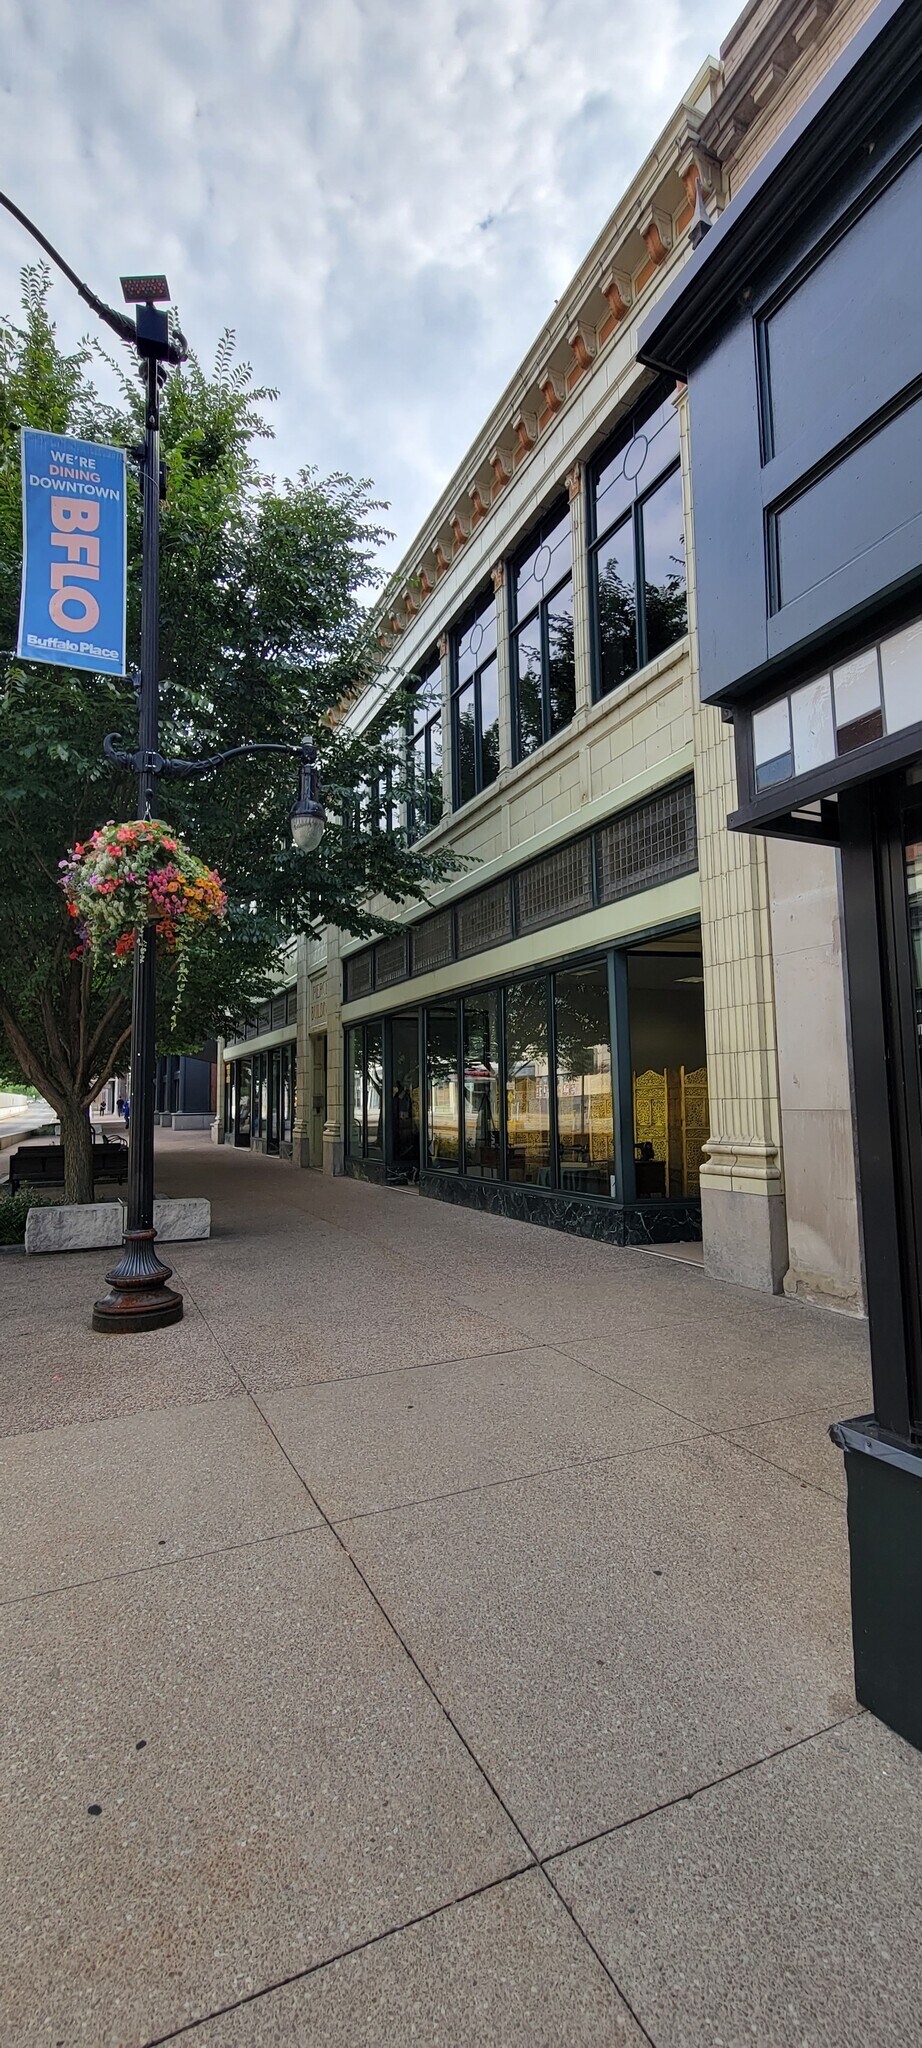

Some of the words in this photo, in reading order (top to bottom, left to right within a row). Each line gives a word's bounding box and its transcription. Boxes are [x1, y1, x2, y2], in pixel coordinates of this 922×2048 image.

[50, 450, 96, 470] WE'RE
[49, 464, 101, 483] DINING
[29, 474, 120, 501] DOWNTOWN
[48, 495, 100, 633] BFLO
[26, 633, 79, 652] Buffalo
[79, 641, 119, 659] Place
